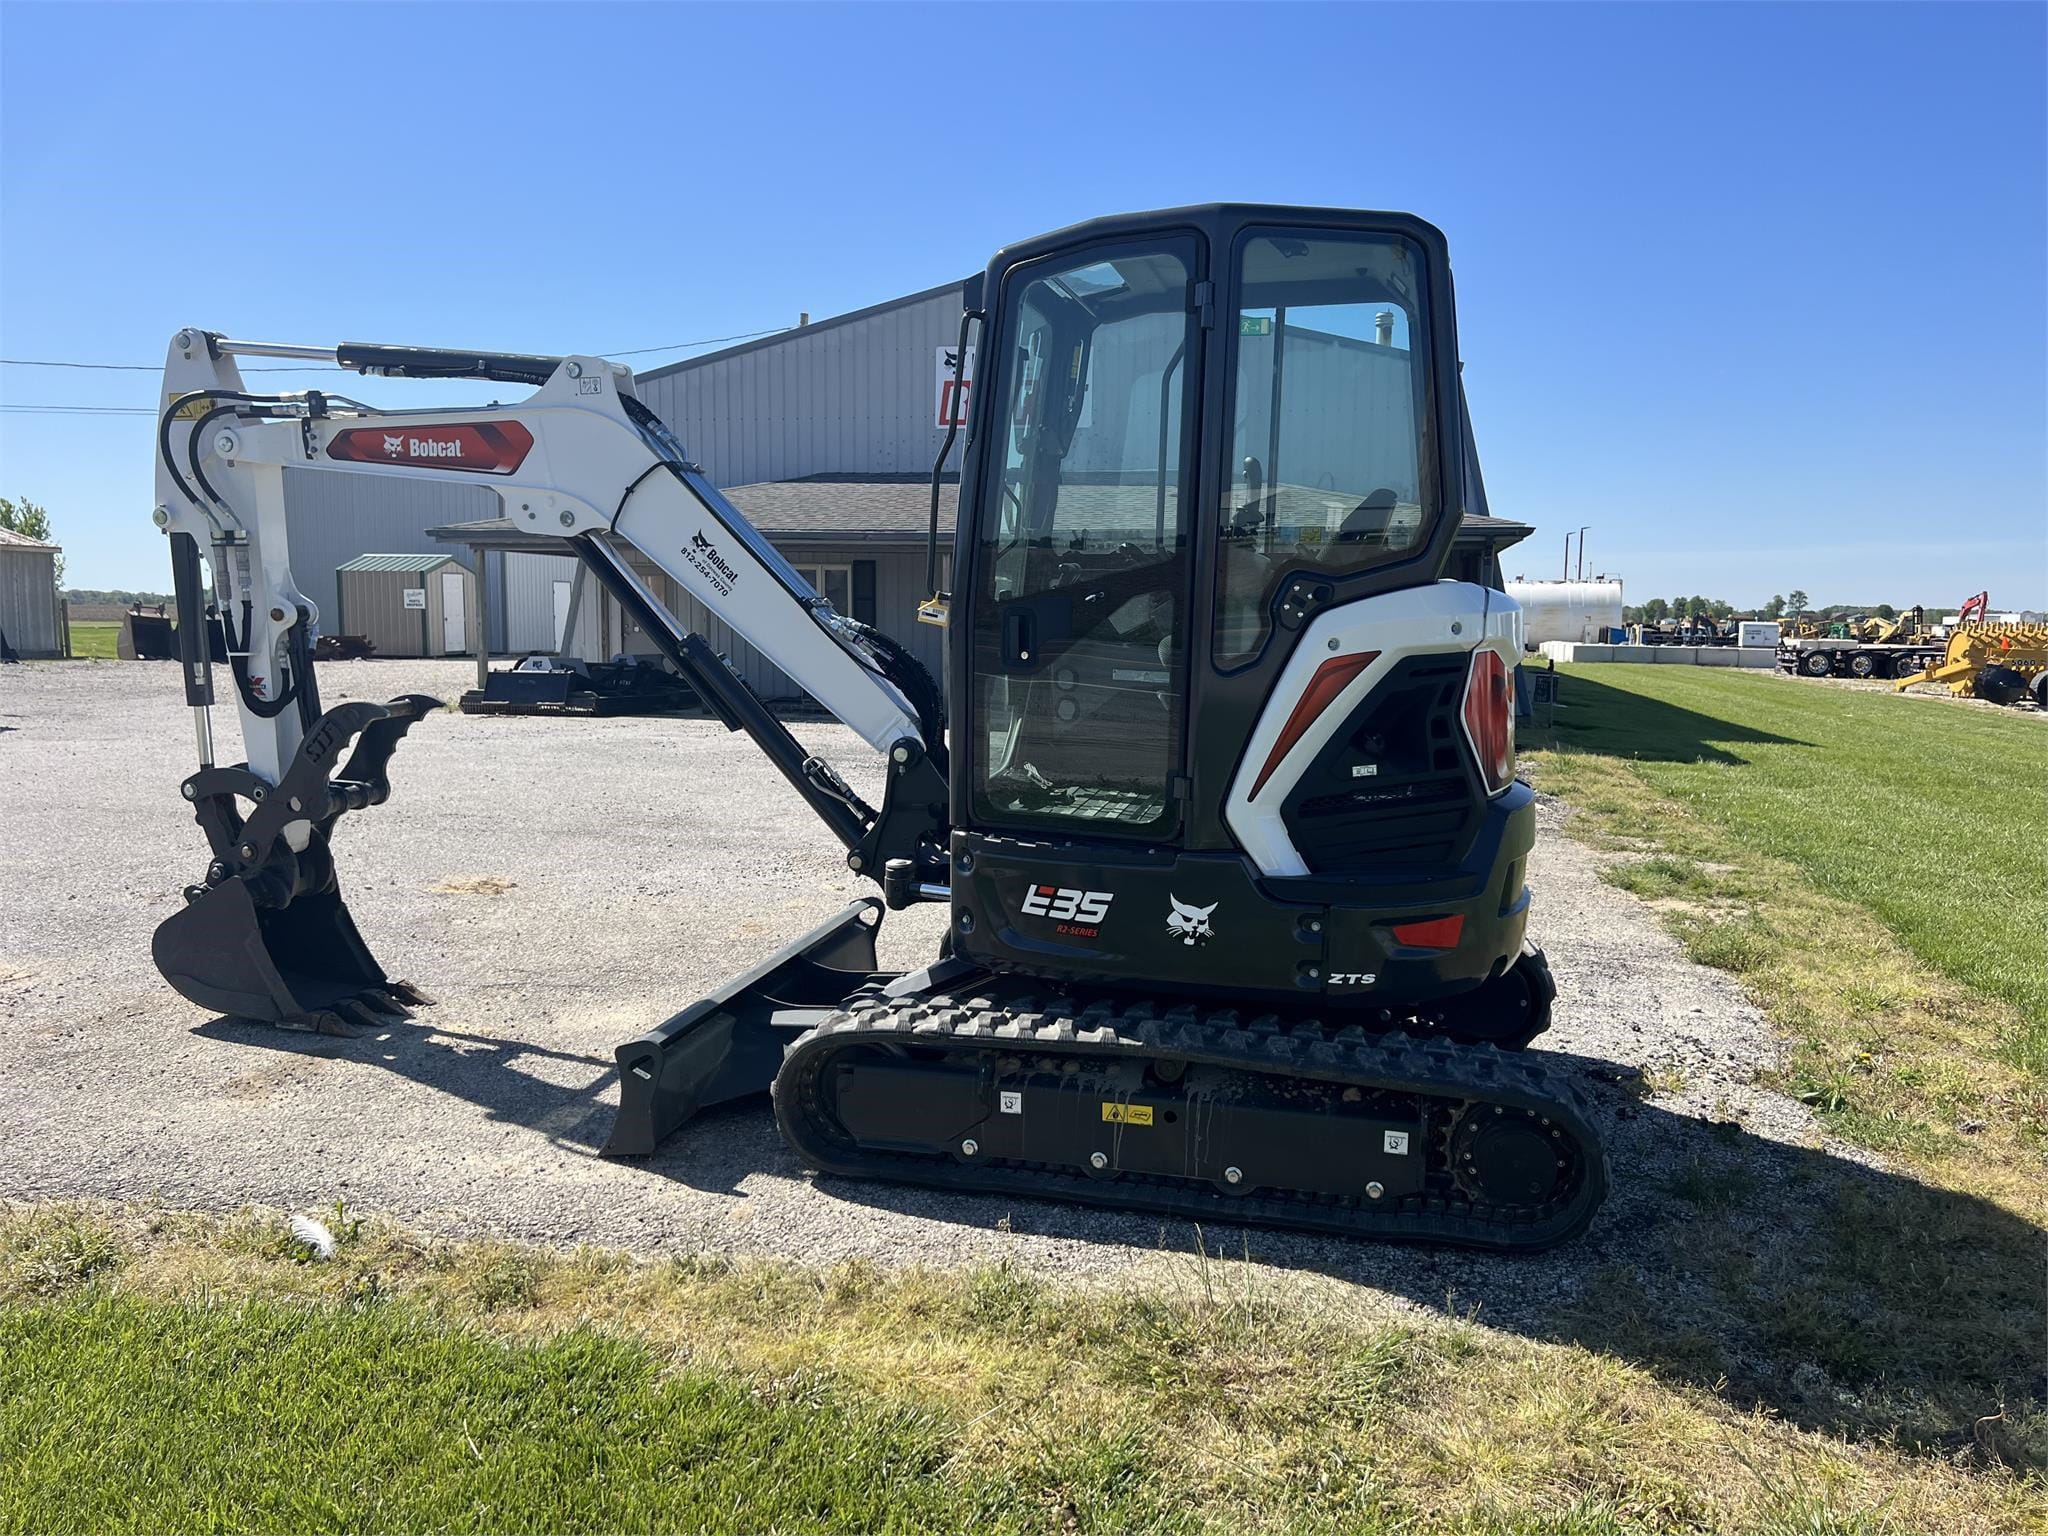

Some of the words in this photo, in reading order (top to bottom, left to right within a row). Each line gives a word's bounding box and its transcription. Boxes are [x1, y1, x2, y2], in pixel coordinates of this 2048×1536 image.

[409, 438, 462, 457] Bobcat
[680, 547, 729, 597] 812-254-7070
[706, 548, 739, 583] Bobcat
[1021, 884, 1114, 924] E35
[1056, 924, 1099, 938] R2-SERIES
[1327, 973, 1377, 985] ZTS
